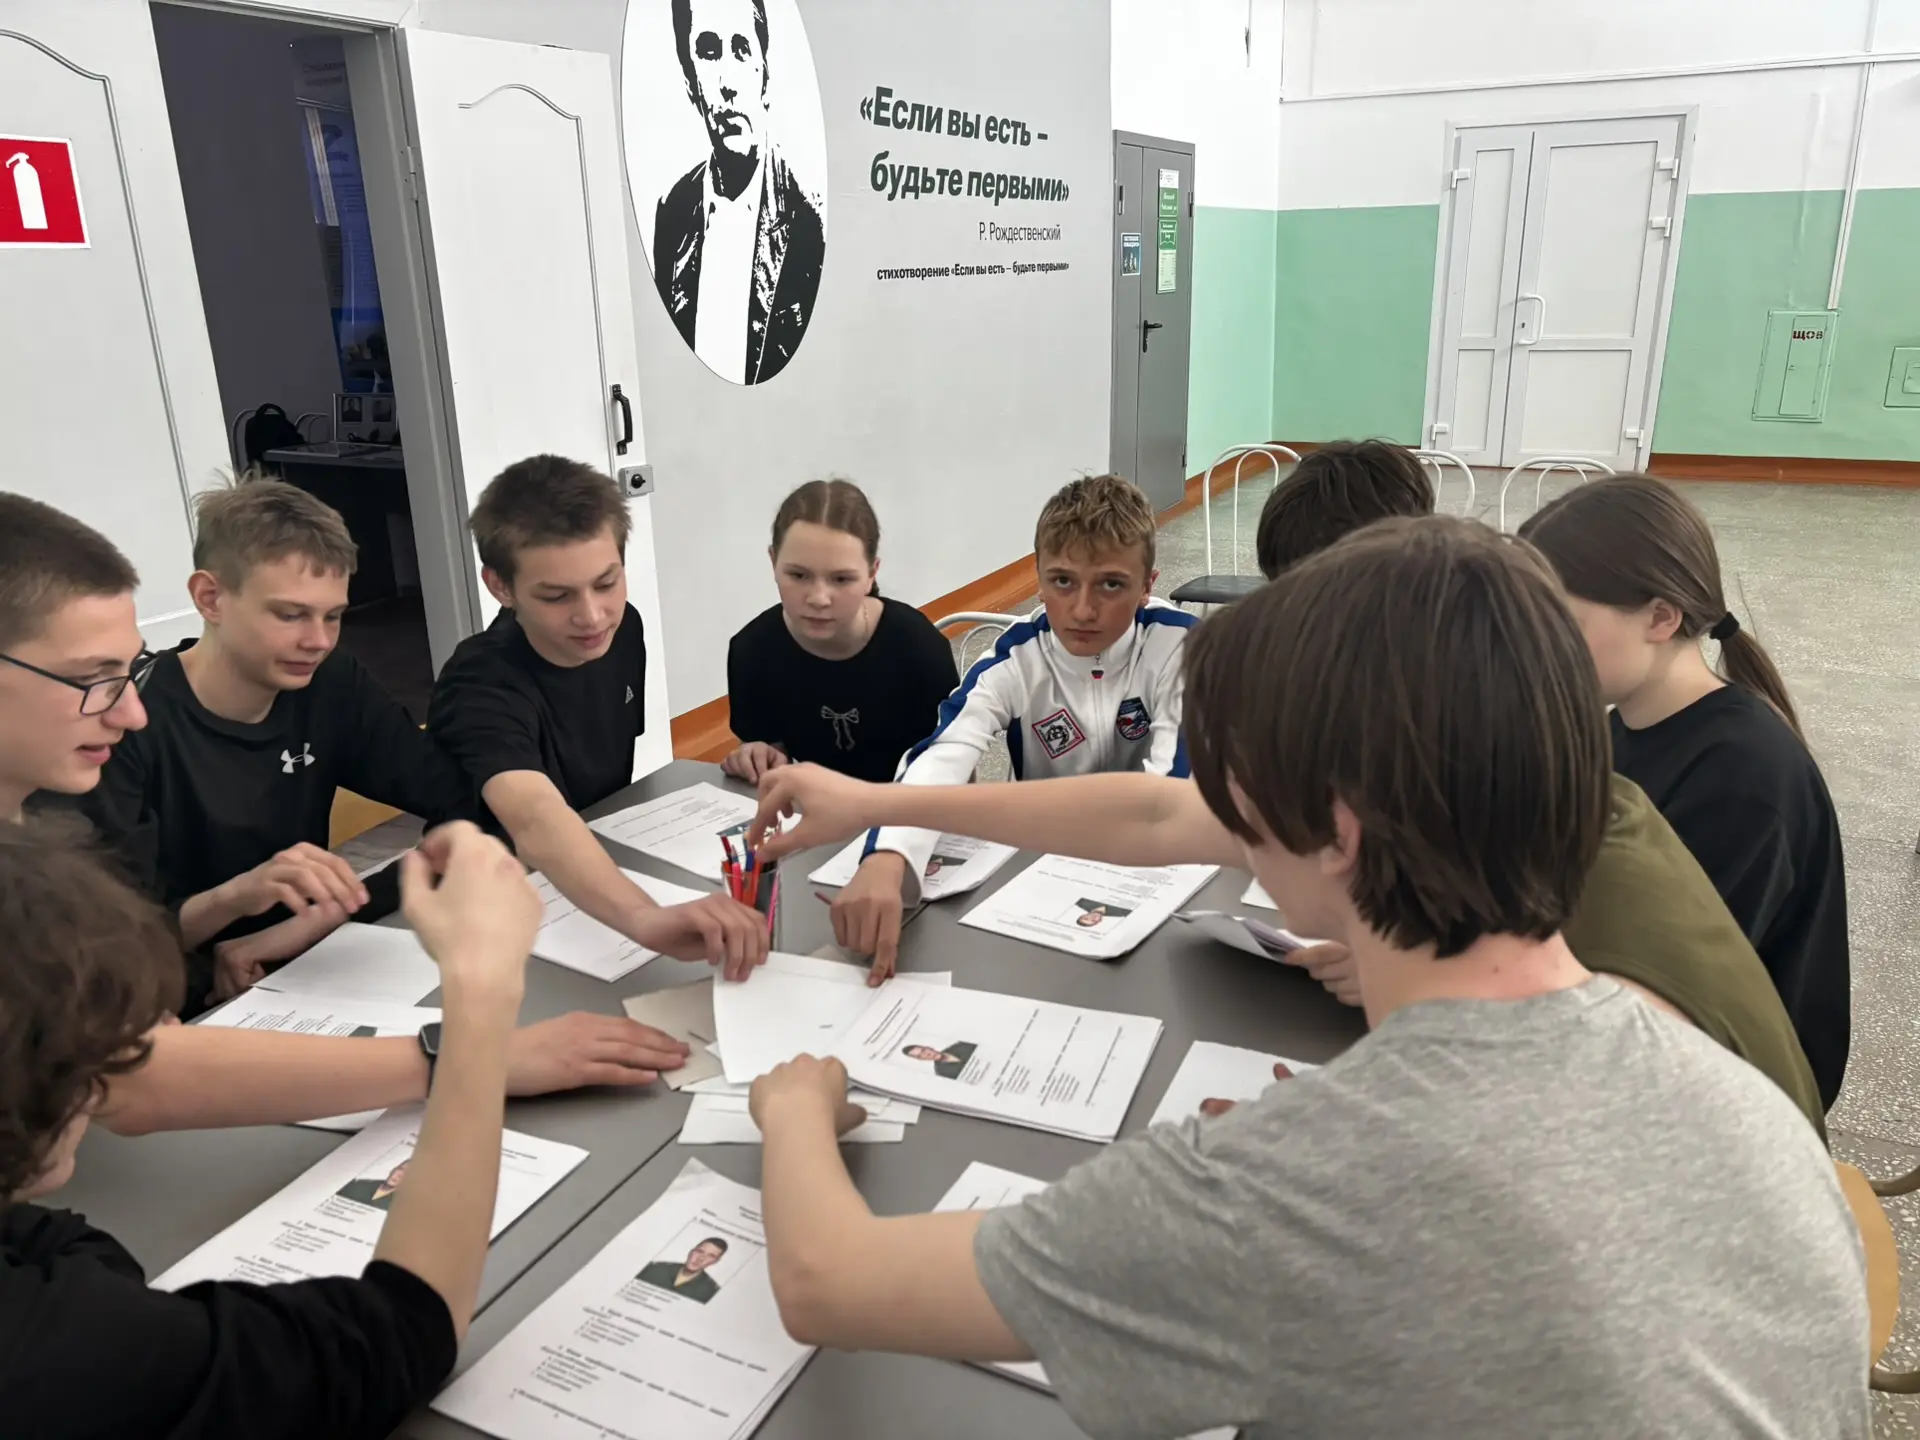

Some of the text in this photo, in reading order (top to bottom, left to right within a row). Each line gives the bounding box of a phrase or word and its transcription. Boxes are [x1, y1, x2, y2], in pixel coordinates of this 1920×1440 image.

[860, 86, 943, 134] «Если
[947, 109, 981, 139] вы
[985, 115, 1032, 146] есть
[870, 150, 1069, 206] будьте первыми»
[979, 221, 1061, 244] Р. Рождественский
[877, 267, 950, 281] стихотворение
[950, 263, 975, 276] «Если
[975, 265, 987, 275] вы
[988, 264, 1005, 275] есть
[1012, 261, 1036, 275] будьте
